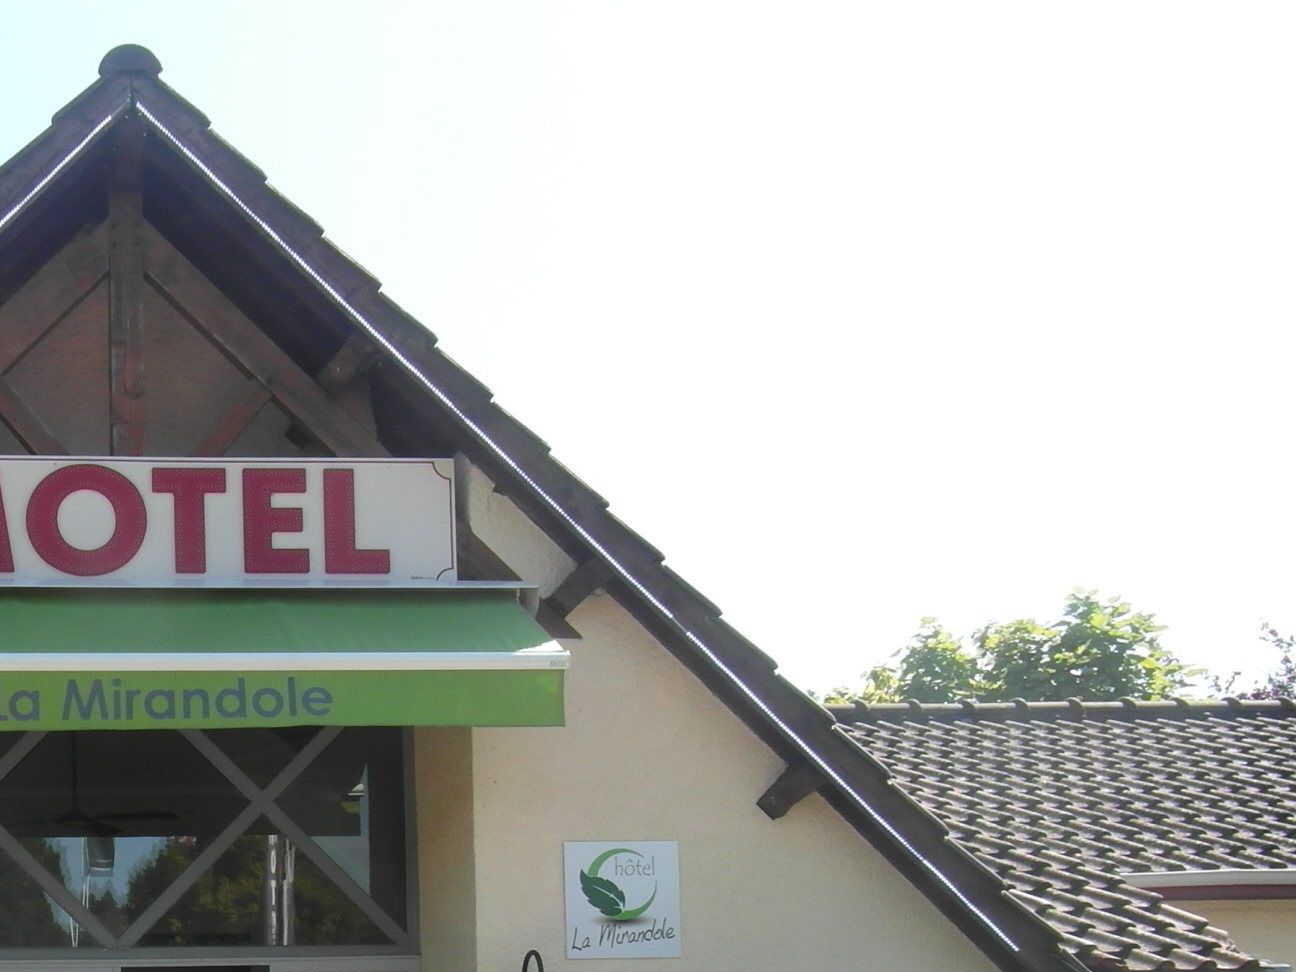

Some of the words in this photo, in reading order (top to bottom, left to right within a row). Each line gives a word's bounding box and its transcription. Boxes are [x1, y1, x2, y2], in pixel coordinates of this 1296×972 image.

[62, 677, 334, 721] Mirandole
[614, 856, 656, 876] hôtel
[571, 926, 592, 951] La
[599, 917, 676, 949] Mirandole
